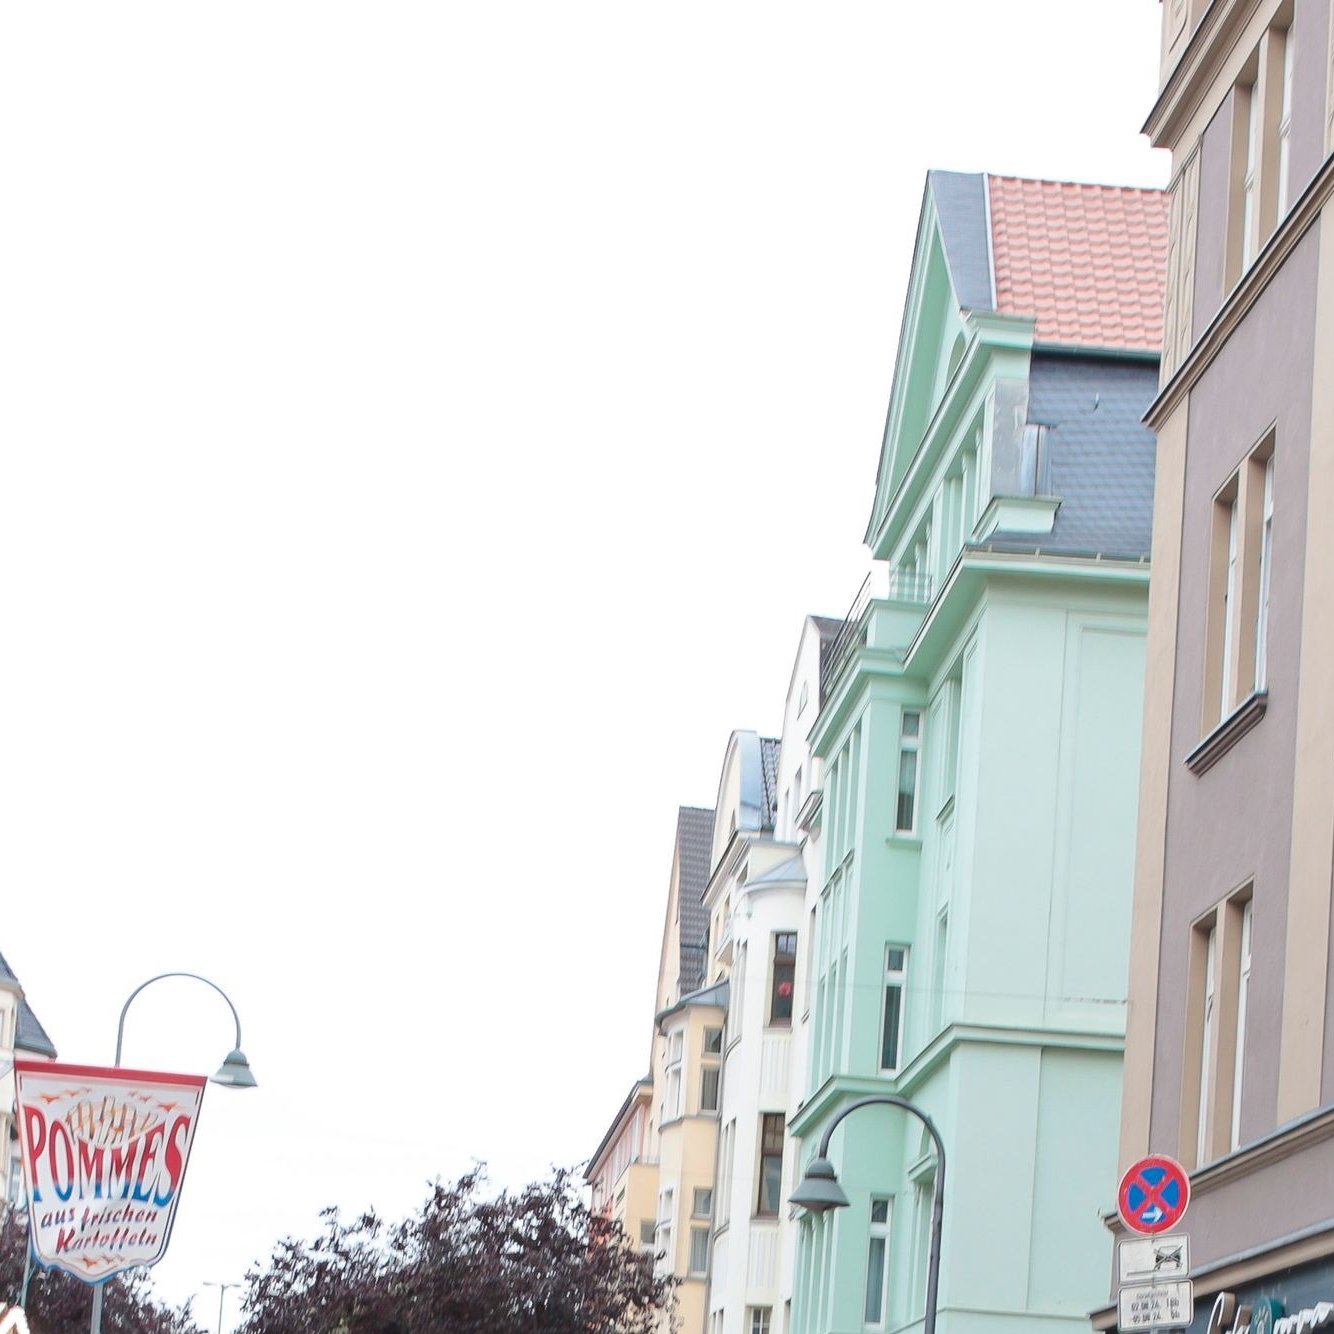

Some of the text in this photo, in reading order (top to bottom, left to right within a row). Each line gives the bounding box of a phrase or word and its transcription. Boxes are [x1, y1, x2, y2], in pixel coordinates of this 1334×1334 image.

[23, 1103, 192, 1208] POMMES
[41, 1203, 158, 1232] aus frischen
[56, 1226, 158, 1255] Kartoffeln
